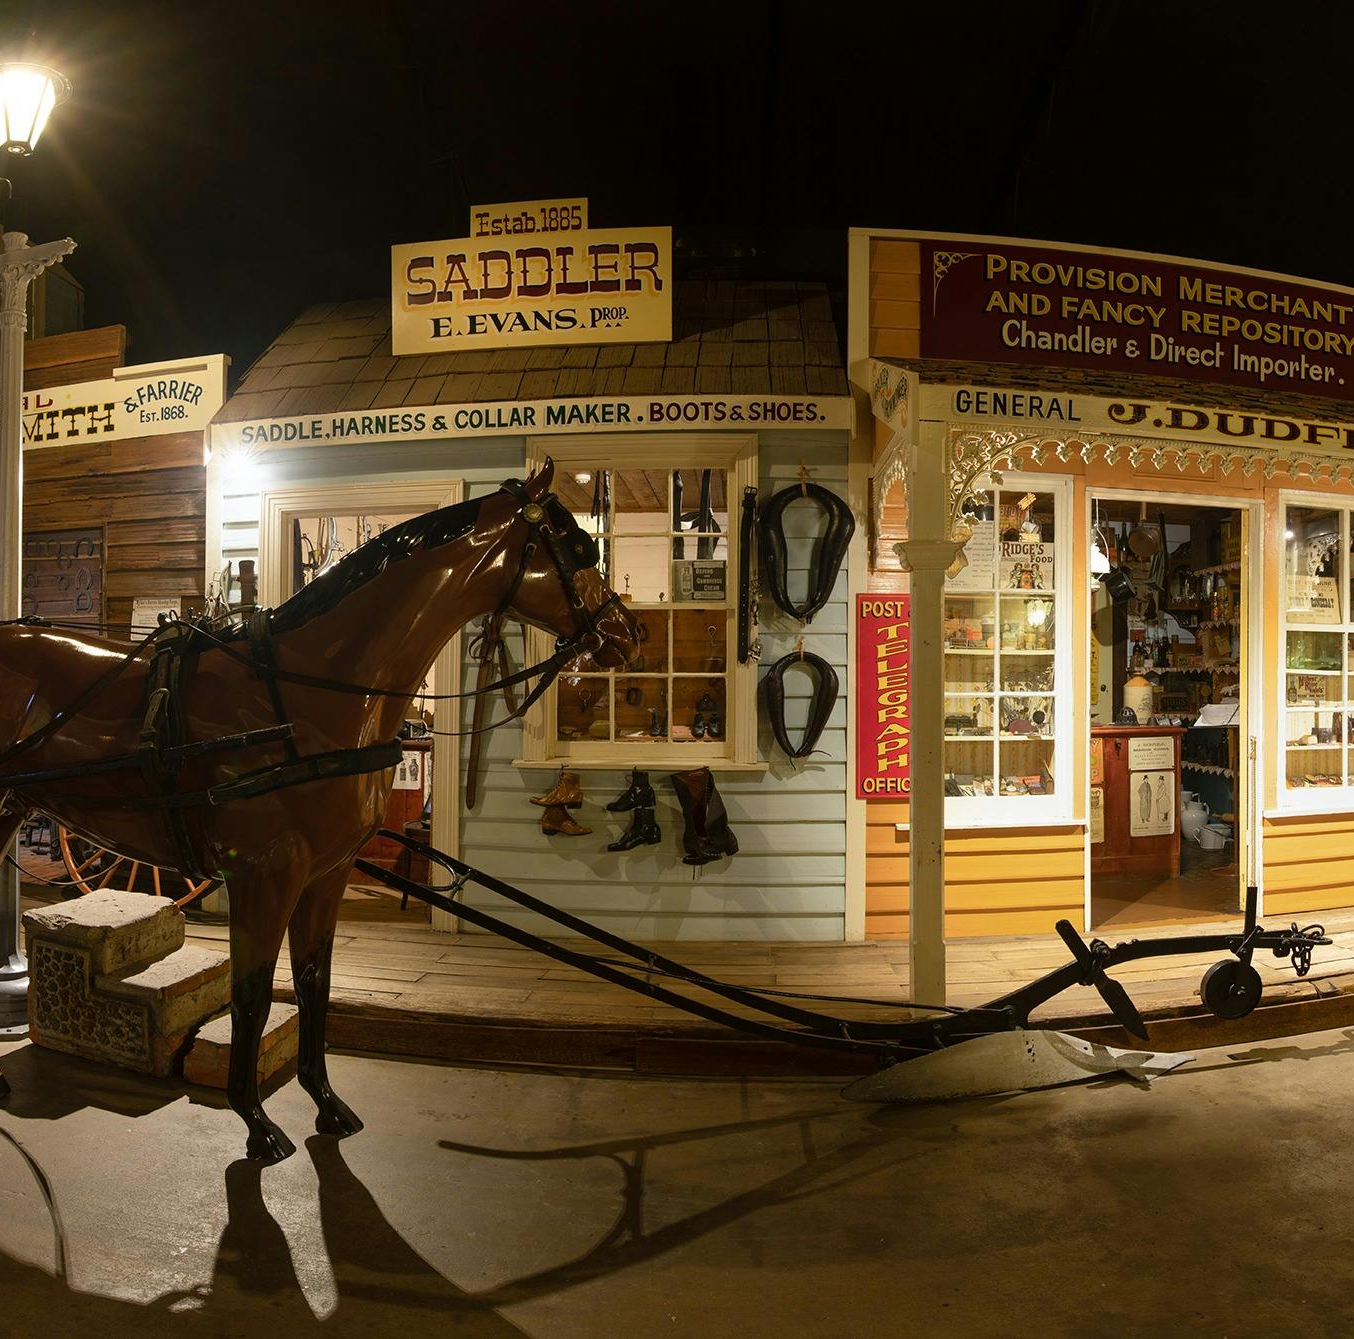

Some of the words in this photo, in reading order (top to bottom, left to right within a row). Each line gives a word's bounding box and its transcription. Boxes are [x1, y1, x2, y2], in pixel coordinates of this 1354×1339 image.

[405, 242, 663, 306] SADDLER
[986, 253, 1162, 298] PROVISION
[1179, 275, 1354, 325] MERCHANT
[985, 290, 1051, 316] AND
[1061, 296, 1167, 328] FANCY
[1002, 319, 1118, 355] Chandler
[1125, 339, 1140, 358] &
[1150, 333, 1224, 368] Direct
[1233, 344, 1345, 385] Importer.
[136, 379, 203, 407] FARRIER
[955, 389, 1082, 422] GENERAL
[331, 411, 426, 437] HARNESS
[432, 415, 448, 431] &
[454, 406, 536, 430] COLLAR
[649, 401, 727, 423] BOOTS
[730, 405, 746, 421] &
[748, 401, 827, 422] SHOES.
[1001, 542, 1045, 557] RIDGE'S
[1030, 555, 1053, 563] FOOD
[862, 601, 905, 619] POST
[876, 622, 911, 773] TELEGRAPH
[862, 776, 911, 793] OFFIC
